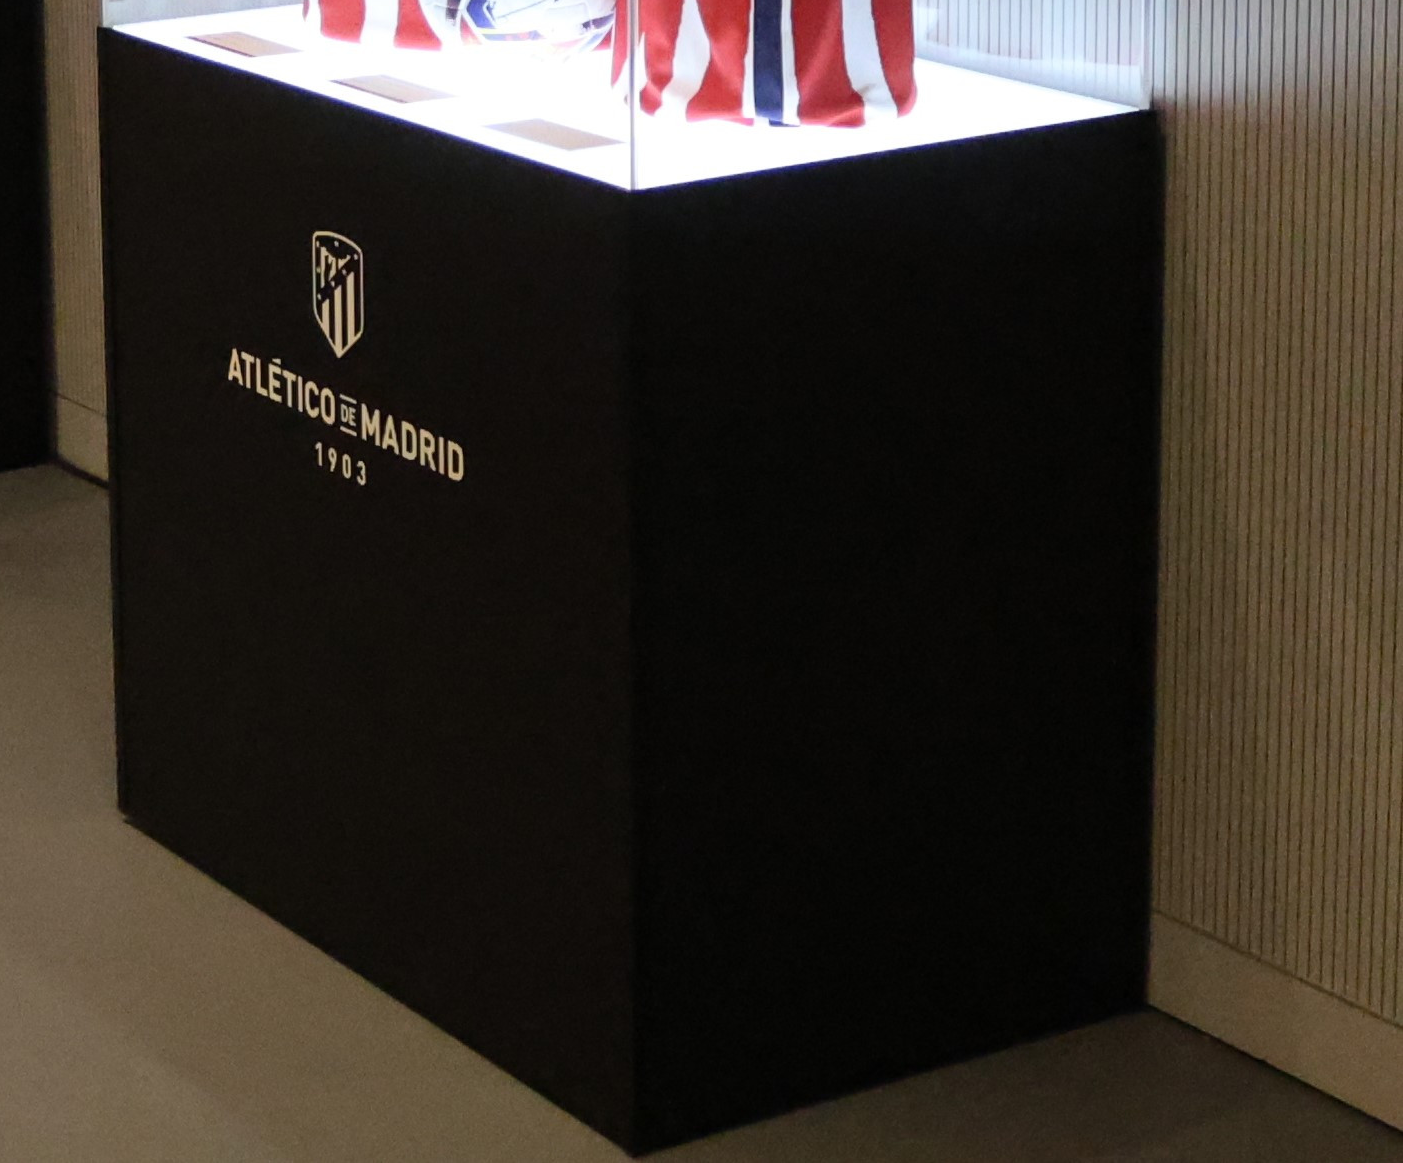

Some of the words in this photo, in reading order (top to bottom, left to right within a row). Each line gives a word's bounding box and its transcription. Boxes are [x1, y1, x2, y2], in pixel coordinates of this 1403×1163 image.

[227, 347, 336, 425] ATLÉTICO
[339, 402, 358, 428] DE
[360, 402, 465, 482] MADRID
[313, 441, 367, 486] 1903
